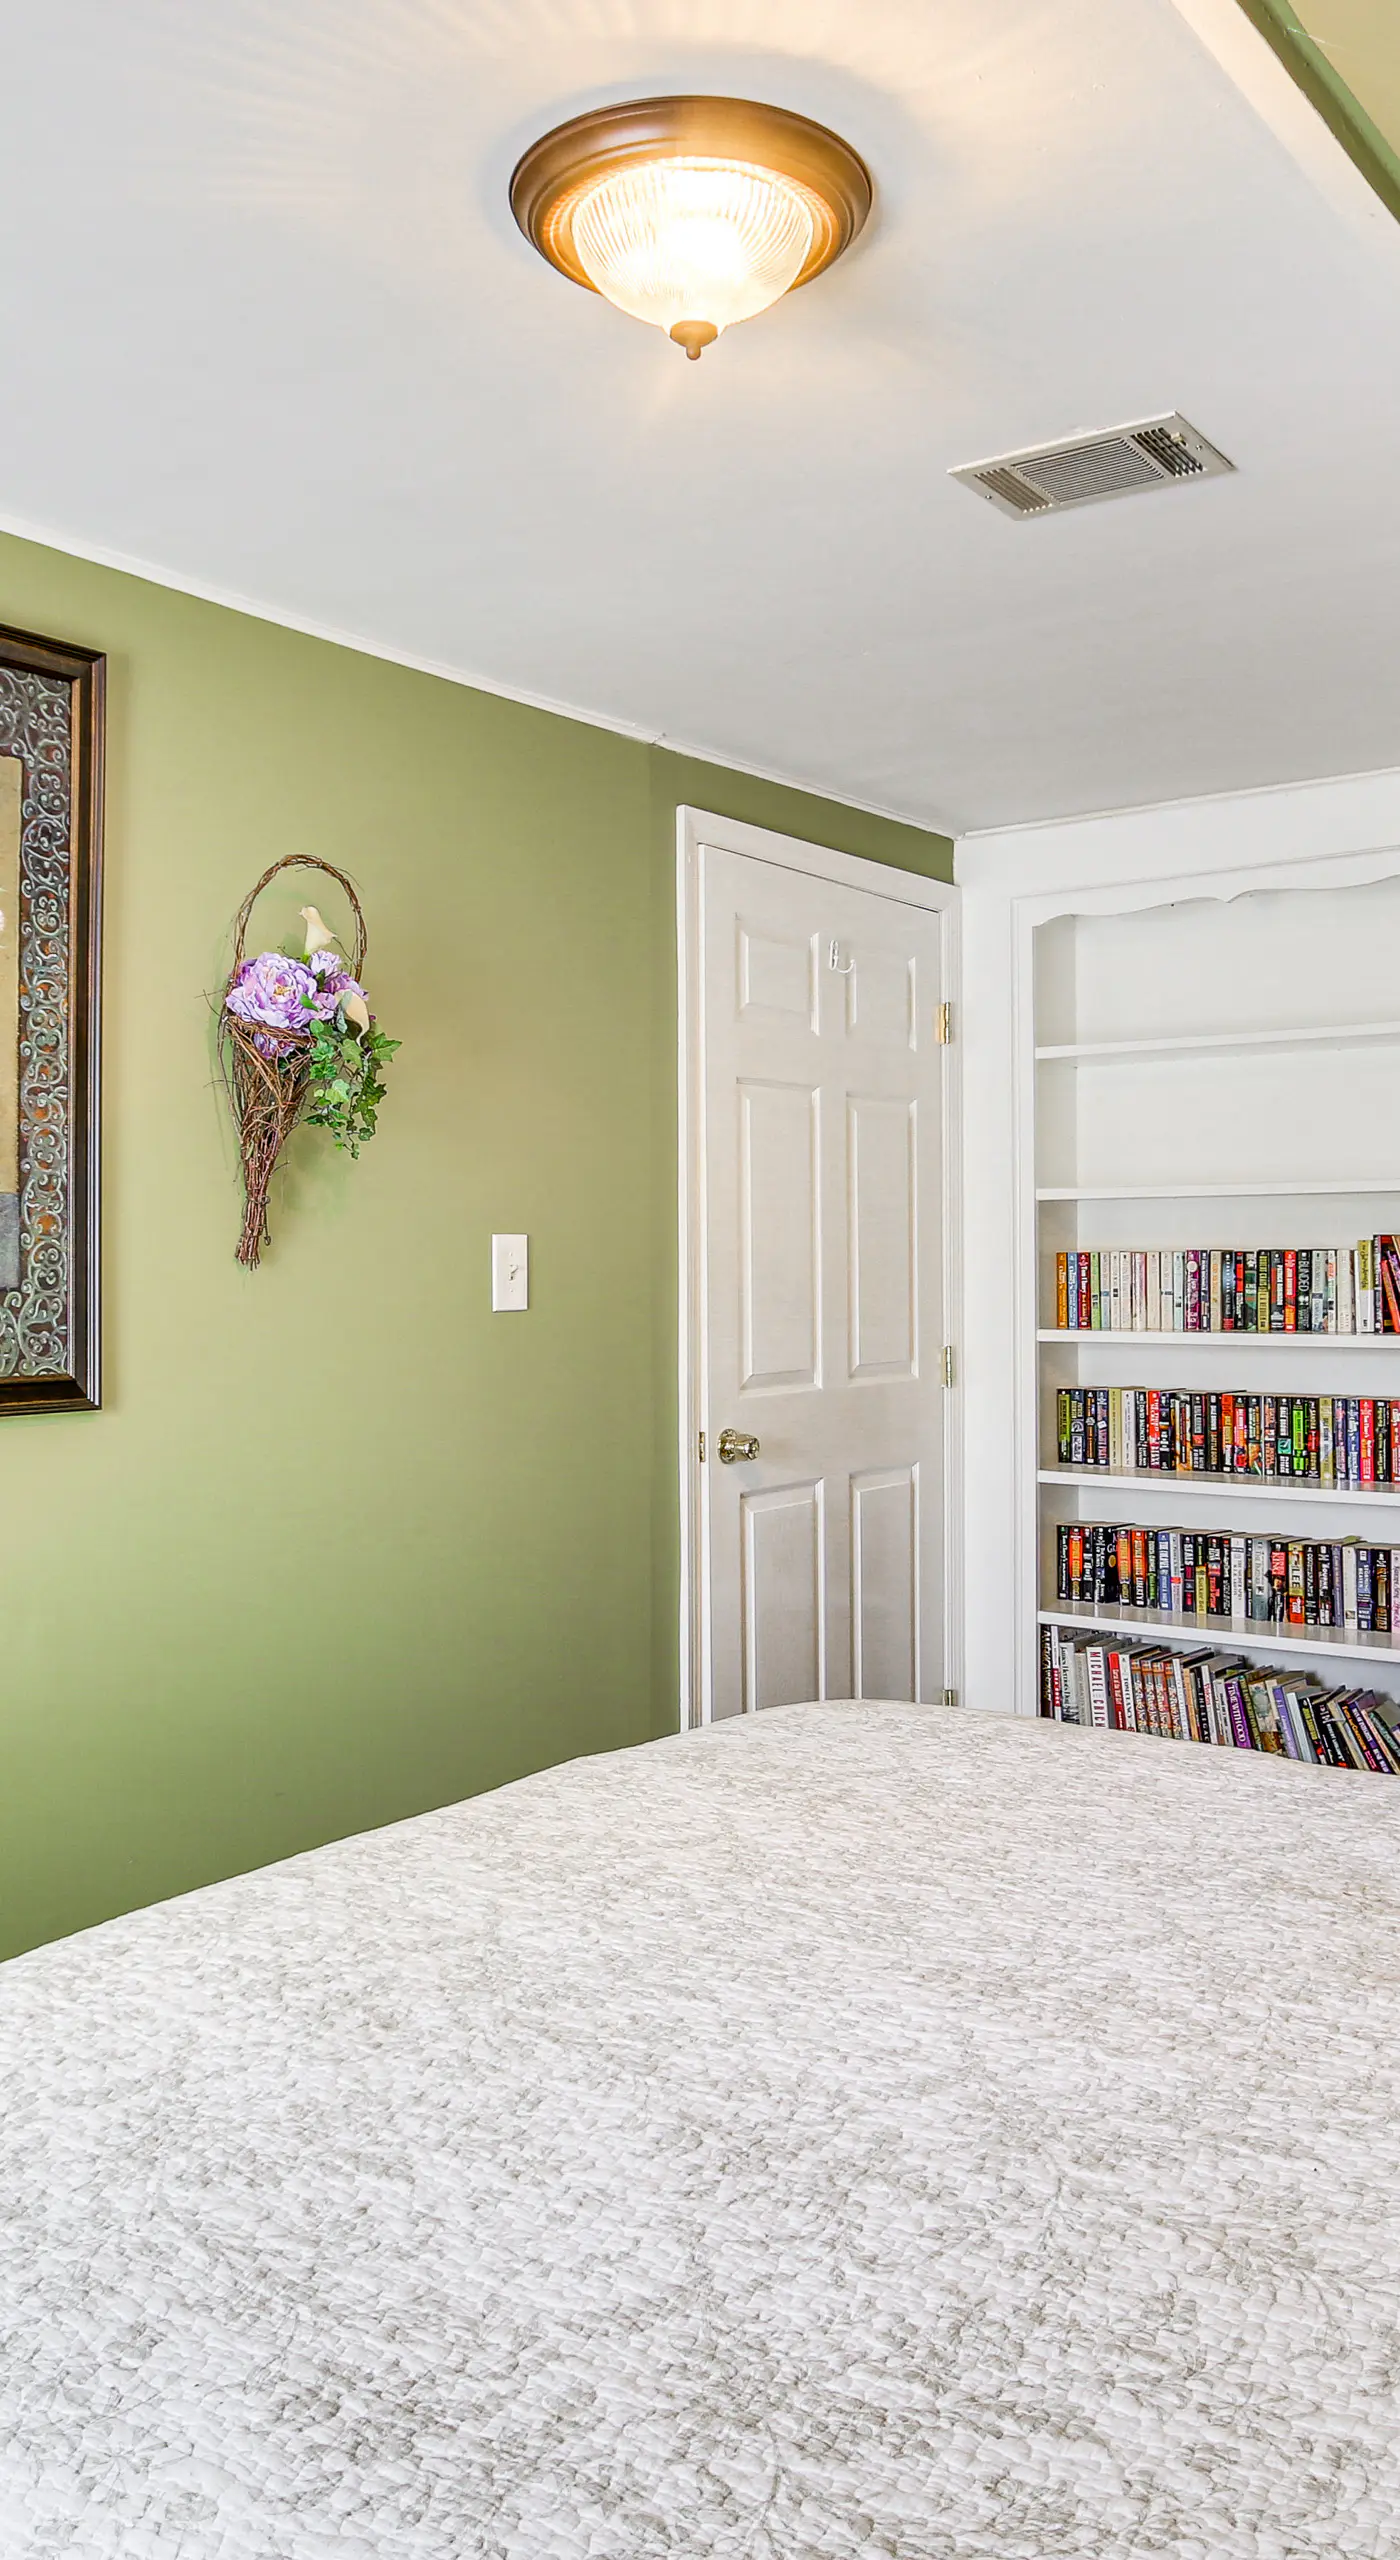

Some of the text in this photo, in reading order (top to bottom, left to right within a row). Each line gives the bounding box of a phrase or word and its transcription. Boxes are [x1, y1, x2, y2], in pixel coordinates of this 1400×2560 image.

[1184, 1543, 1193, 1566] SEALS
[1272, 1552, 1280, 1576] KING
[1136, 1576, 1144, 1600] LIBERTY
[1291, 1569, 1300, 1588] LEE
[1060, 1646, 1068, 1665] James
[1092, 1651, 1106, 1727] MICHAEL CRICH
[1125, 1693, 1133, 1719] CLANCY
[1227, 1685, 1246, 1742] TIME WITH GOD
